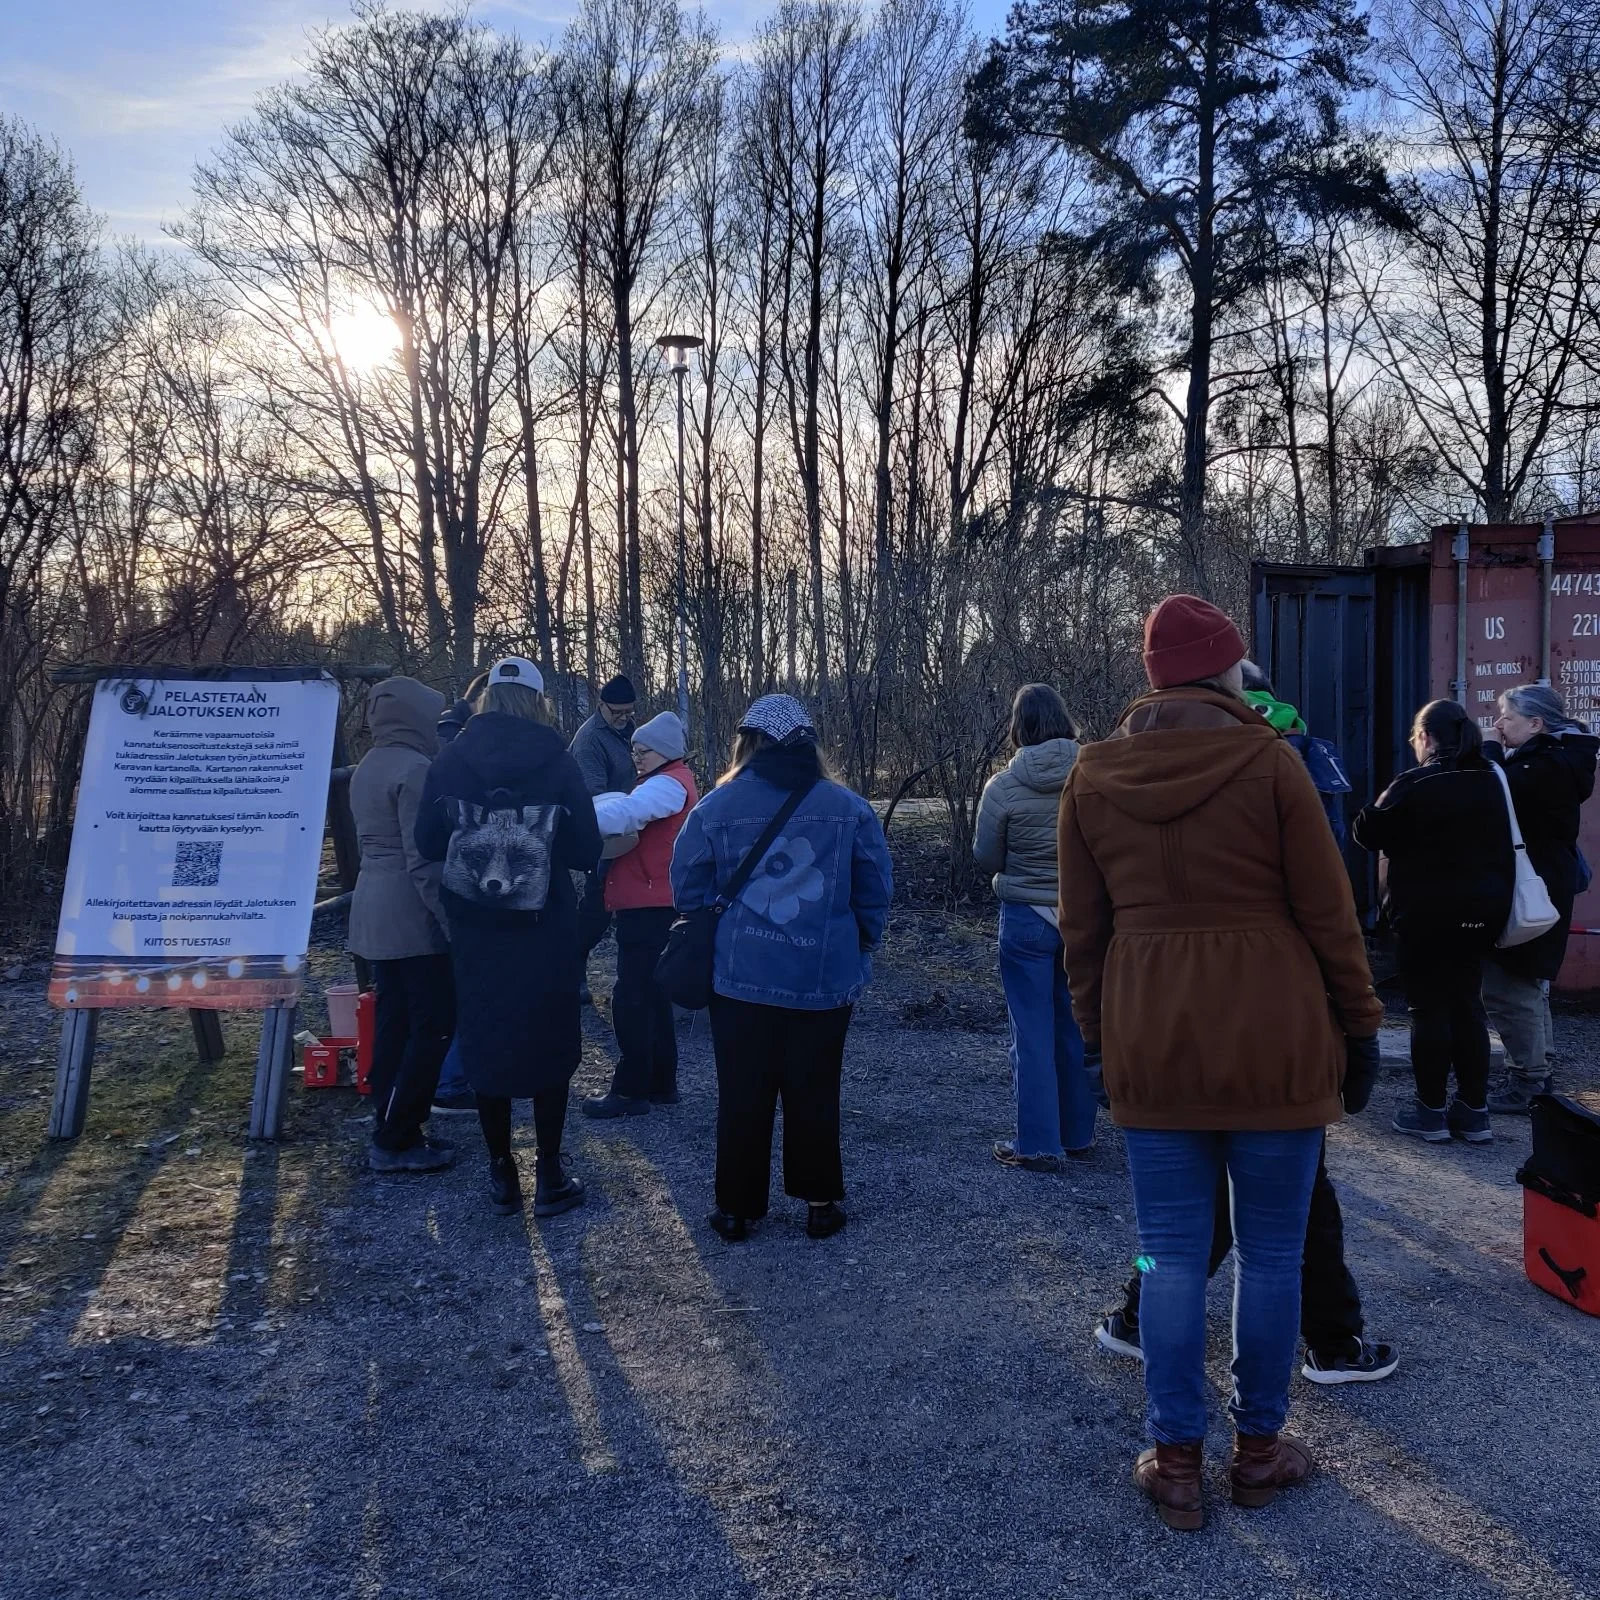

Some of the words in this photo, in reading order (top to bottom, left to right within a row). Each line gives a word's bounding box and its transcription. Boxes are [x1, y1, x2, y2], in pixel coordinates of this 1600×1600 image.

[1484, 616, 1505, 640] US
[1572, 613, 1600, 636] 221
[1476, 663, 1493, 677] MAX
[1495, 662, 1522, 675] GROSS
[1560, 660, 1590, 672] 24.000
[1590, 659, 1600, 672] KG
[1560, 672, 1590, 684] 52.910
[1590, 672, 1600, 683] LB
[165, 691, 267, 703] PELASTETAAN
[1476, 689, 1496, 702] TARE
[1565, 685, 1590, 698] 2.340
[1591, 685, 1600, 697] KG
[1564, 697, 1590, 710] 5.160
[148, 706, 244, 717] JALOTUKSEN
[247, 707, 280, 717] KOTI
[1477, 716, 1494, 728] NET
[1590, 711, 1600, 722] KG
[1590, 722, 1600, 734] LB
[153, 729, 203, 738] Keräämme
[204, 730, 275, 740] vapaamuotoisia
[254, 741, 274, 750] sekä
[176, 753, 226, 761] Jalotuksen
[228, 753, 248, 763] työn
[248, 752, 305, 762] jatkumiseksi
[114, 762, 152, 771] Keravan
[206, 764, 247, 772] Kartanon
[249, 763, 304, 772] rakennukset
[124, 775, 168, 785] myydään
[235, 775, 280, 784] lähiaikoina
[280, 775, 290, 784] ja
[168, 787, 211, 795] osallistua
[106, 810, 125, 820] Voit
[126, 811, 171, 821] kirjoittaa
[172, 812, 235, 821] kannatuksesi
[237, 811, 266, 820] tämän
[268, 810, 299, 819] koodin
[138, 824, 170, 832] kautta
[171, 824, 219, 834] löytyvään
[220, 824, 265, 834] kyselyyn.
[85, 898, 170, 909] Allekirjoitettavan
[172, 899, 212, 908] adressin
[213, 899, 243, 909] löydät
[243, 898, 297, 908] Jalotuksen
[113, 911, 158, 921] kaupasta
[157, 912, 168, 922] ja
[143, 937, 178, 946] KIITOS
[744, 926, 816, 946] marimkko
